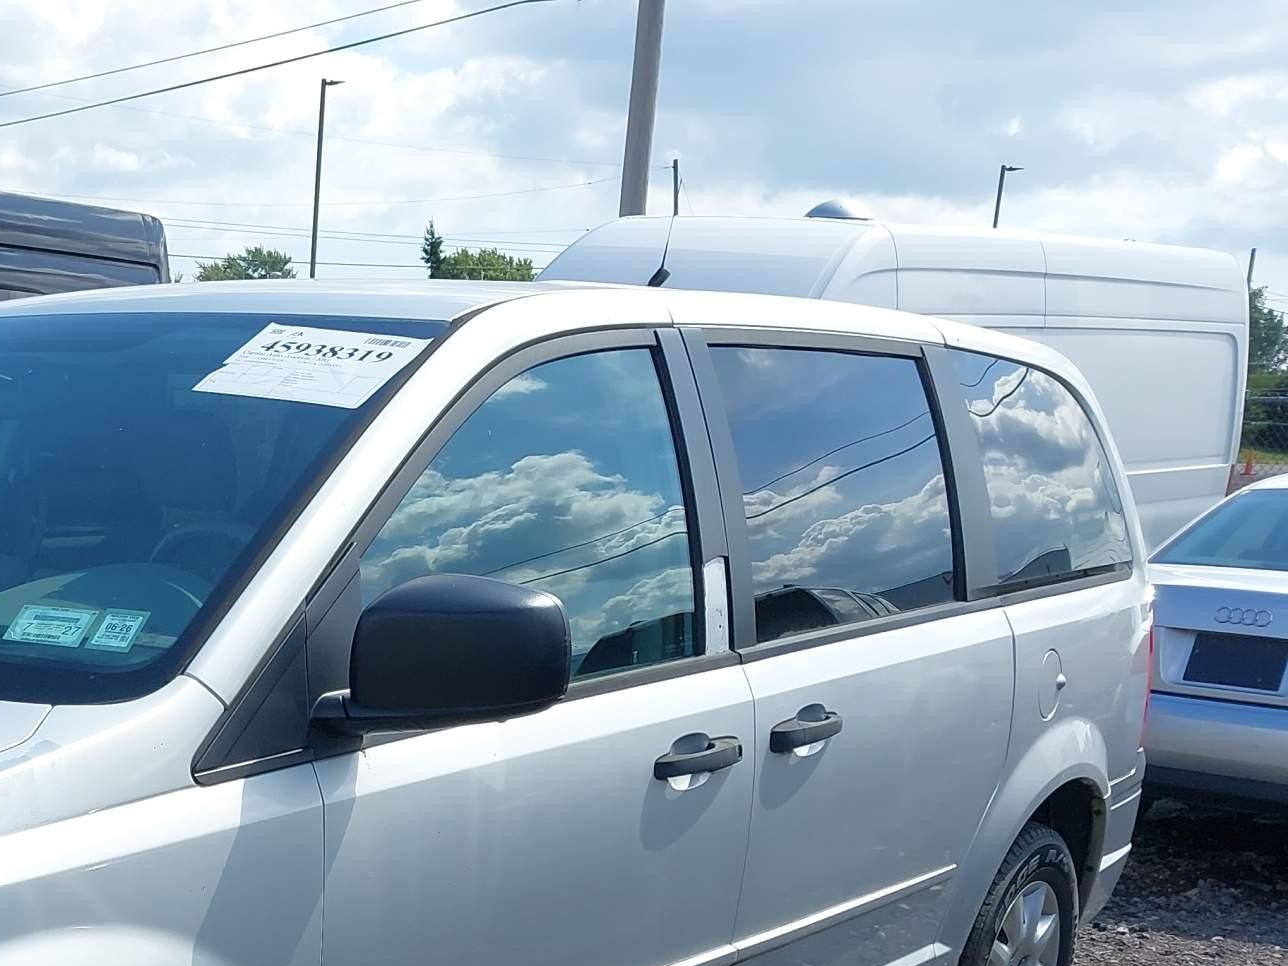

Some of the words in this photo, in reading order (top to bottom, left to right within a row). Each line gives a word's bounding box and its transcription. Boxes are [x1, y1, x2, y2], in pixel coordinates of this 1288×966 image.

[261, 340, 393, 363] 45938319
[23, 622, 33, 631] 7
[62, 625, 82, 636] 27
